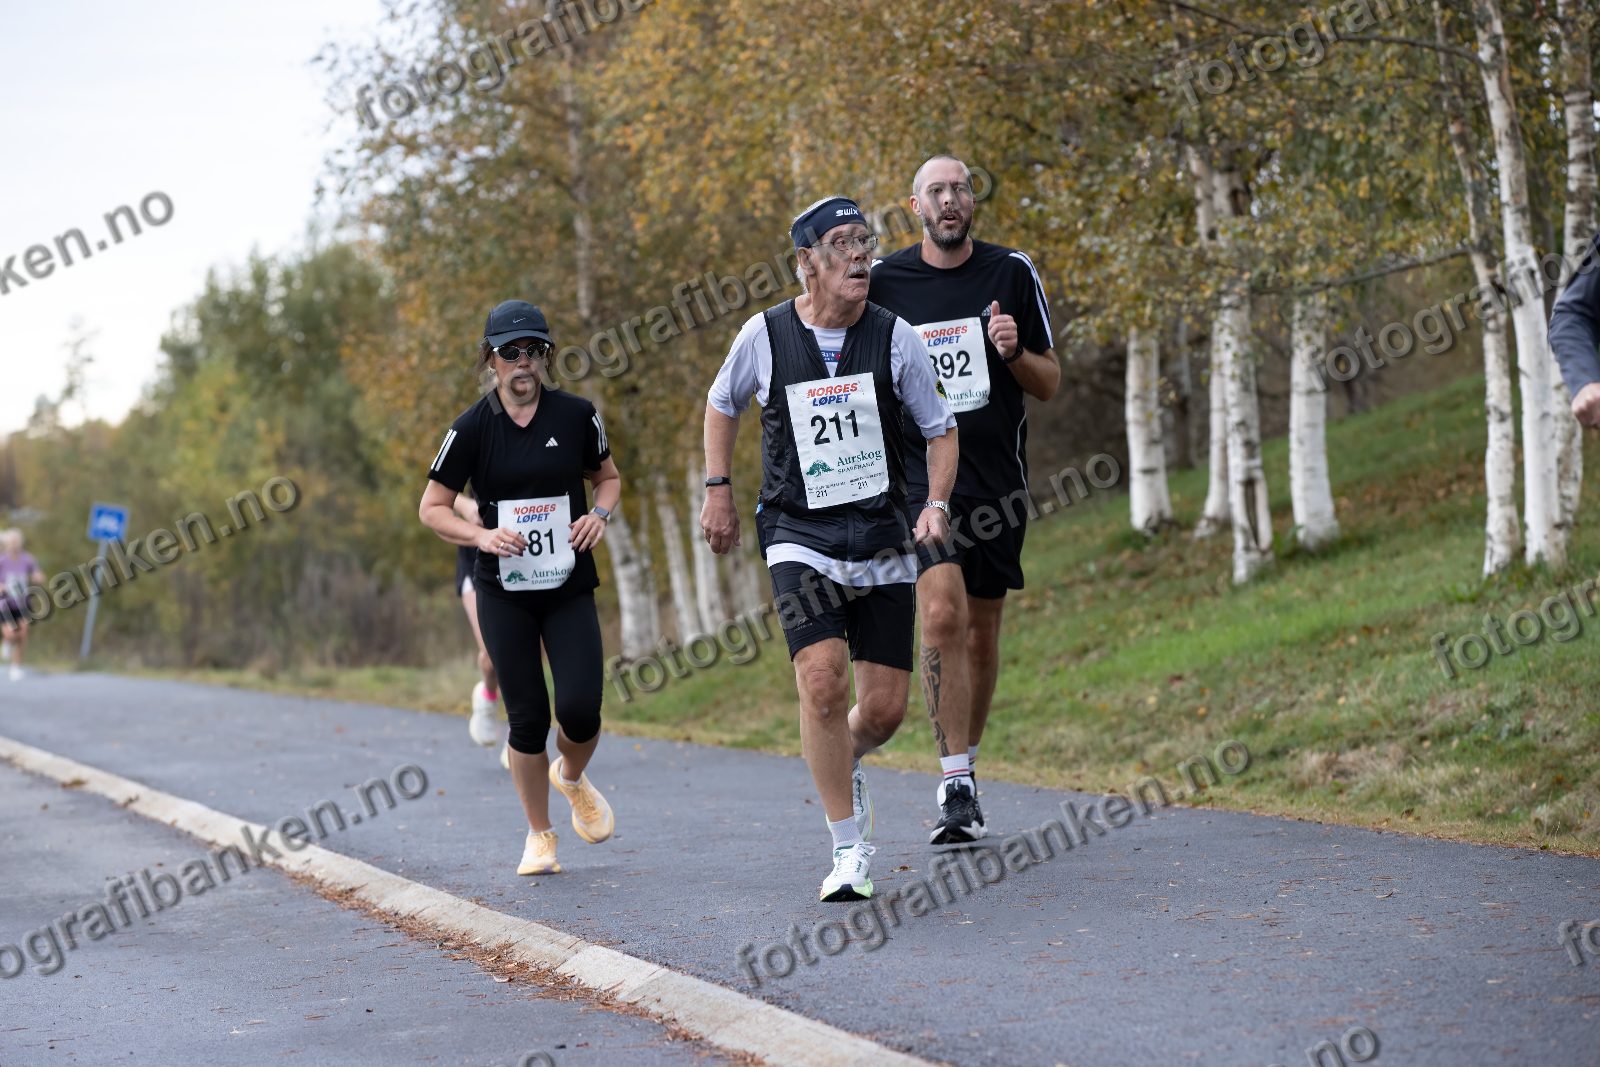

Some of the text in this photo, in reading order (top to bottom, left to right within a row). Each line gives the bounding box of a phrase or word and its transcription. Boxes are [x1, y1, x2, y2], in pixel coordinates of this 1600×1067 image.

[923, 325, 968, 339] NORGES
[927, 335, 961, 347] LØPET
[806, 382, 859, 399] NORGES
[812, 393, 851, 407] LØPET
[810, 409, 859, 446] 211
[837, 449, 883, 467] Aurskog
[857, 480, 868, 490] 211
[815, 489, 828, 498] 211
[513, 503, 557, 515] NORGES
[516, 513, 550, 523] LØPET
[518, 528, 555, 556] 81
